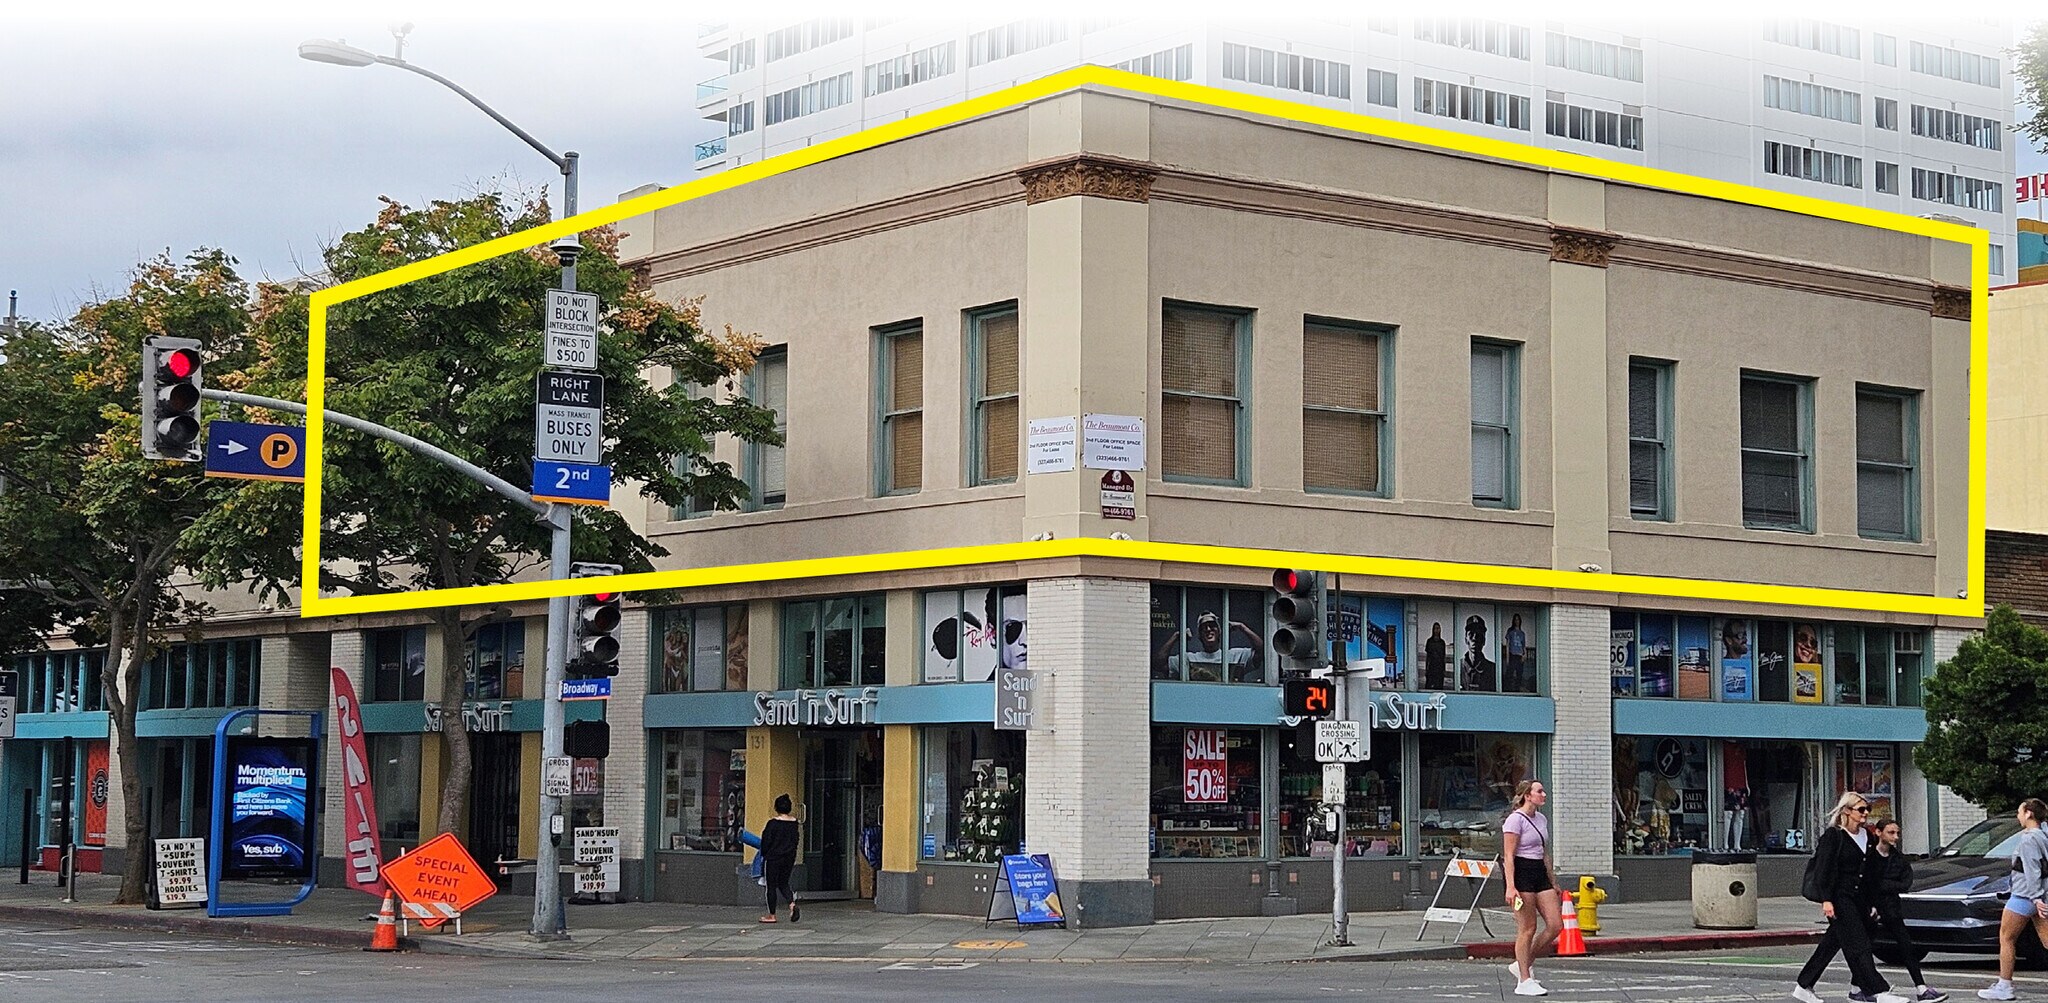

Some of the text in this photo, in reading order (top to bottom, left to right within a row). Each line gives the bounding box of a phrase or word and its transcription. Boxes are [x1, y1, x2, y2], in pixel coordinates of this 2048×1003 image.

[557, 296, 588, 308] DO NOT
[556, 308, 589, 322] BLOCK
[549, 321, 595, 332] INTERSECTION
[553, 337, 590, 349] FINES TO
[557, 349, 585, 362] $500
[551, 378, 590, 390] RIGHT
[552, 391, 589, 403] LANE
[547, 420, 592, 437] BUSES
[1085, 421, 1098, 429] The
[272, 440, 290, 461] P
[552, 440, 586, 455] ONLY
[556, 468, 590, 489] 2nd
[563, 681, 598, 696] Broadway
[1004, 672, 1038, 692] Sand
[1014, 692, 1027, 710] 'n
[1306, 687, 1327, 710] 24
[754, 688, 800, 726] Sand
[824, 686, 870, 725] Surf
[1386, 692, 1447, 730] Surf
[473, 701, 513, 732] Surf
[1004, 707, 1034, 726] Surf
[1320, 722, 1355, 730] DIAGONAL
[750, 736, 765, 750] 131
[1186, 730, 1225, 760] SALE
[1318, 742, 1334, 757] OK
[548, 759, 569, 767] CROSS
[238, 764, 306, 777] Momentum,
[237, 775, 293, 787] multiplied
[1212, 785, 1225, 799] OFF
[169, 851, 190, 859] SURF
[242, 843, 282, 855] Yes, svb
[580, 847, 614, 855] SOUVENIR
[157, 860, 196, 868] SOUVENIR
[415, 856, 468, 874] SPECIAL
[160, 868, 198, 877] T-SHIRTS
[580, 873, 605, 881] HOODIE
[169, 877, 191, 885] $9.99
[418, 872, 459, 888] EVENT
[583, 882, 605, 890] $19.99
[165, 885, 198, 893] HOODIES
[413, 888, 458, 903] AHEAD
